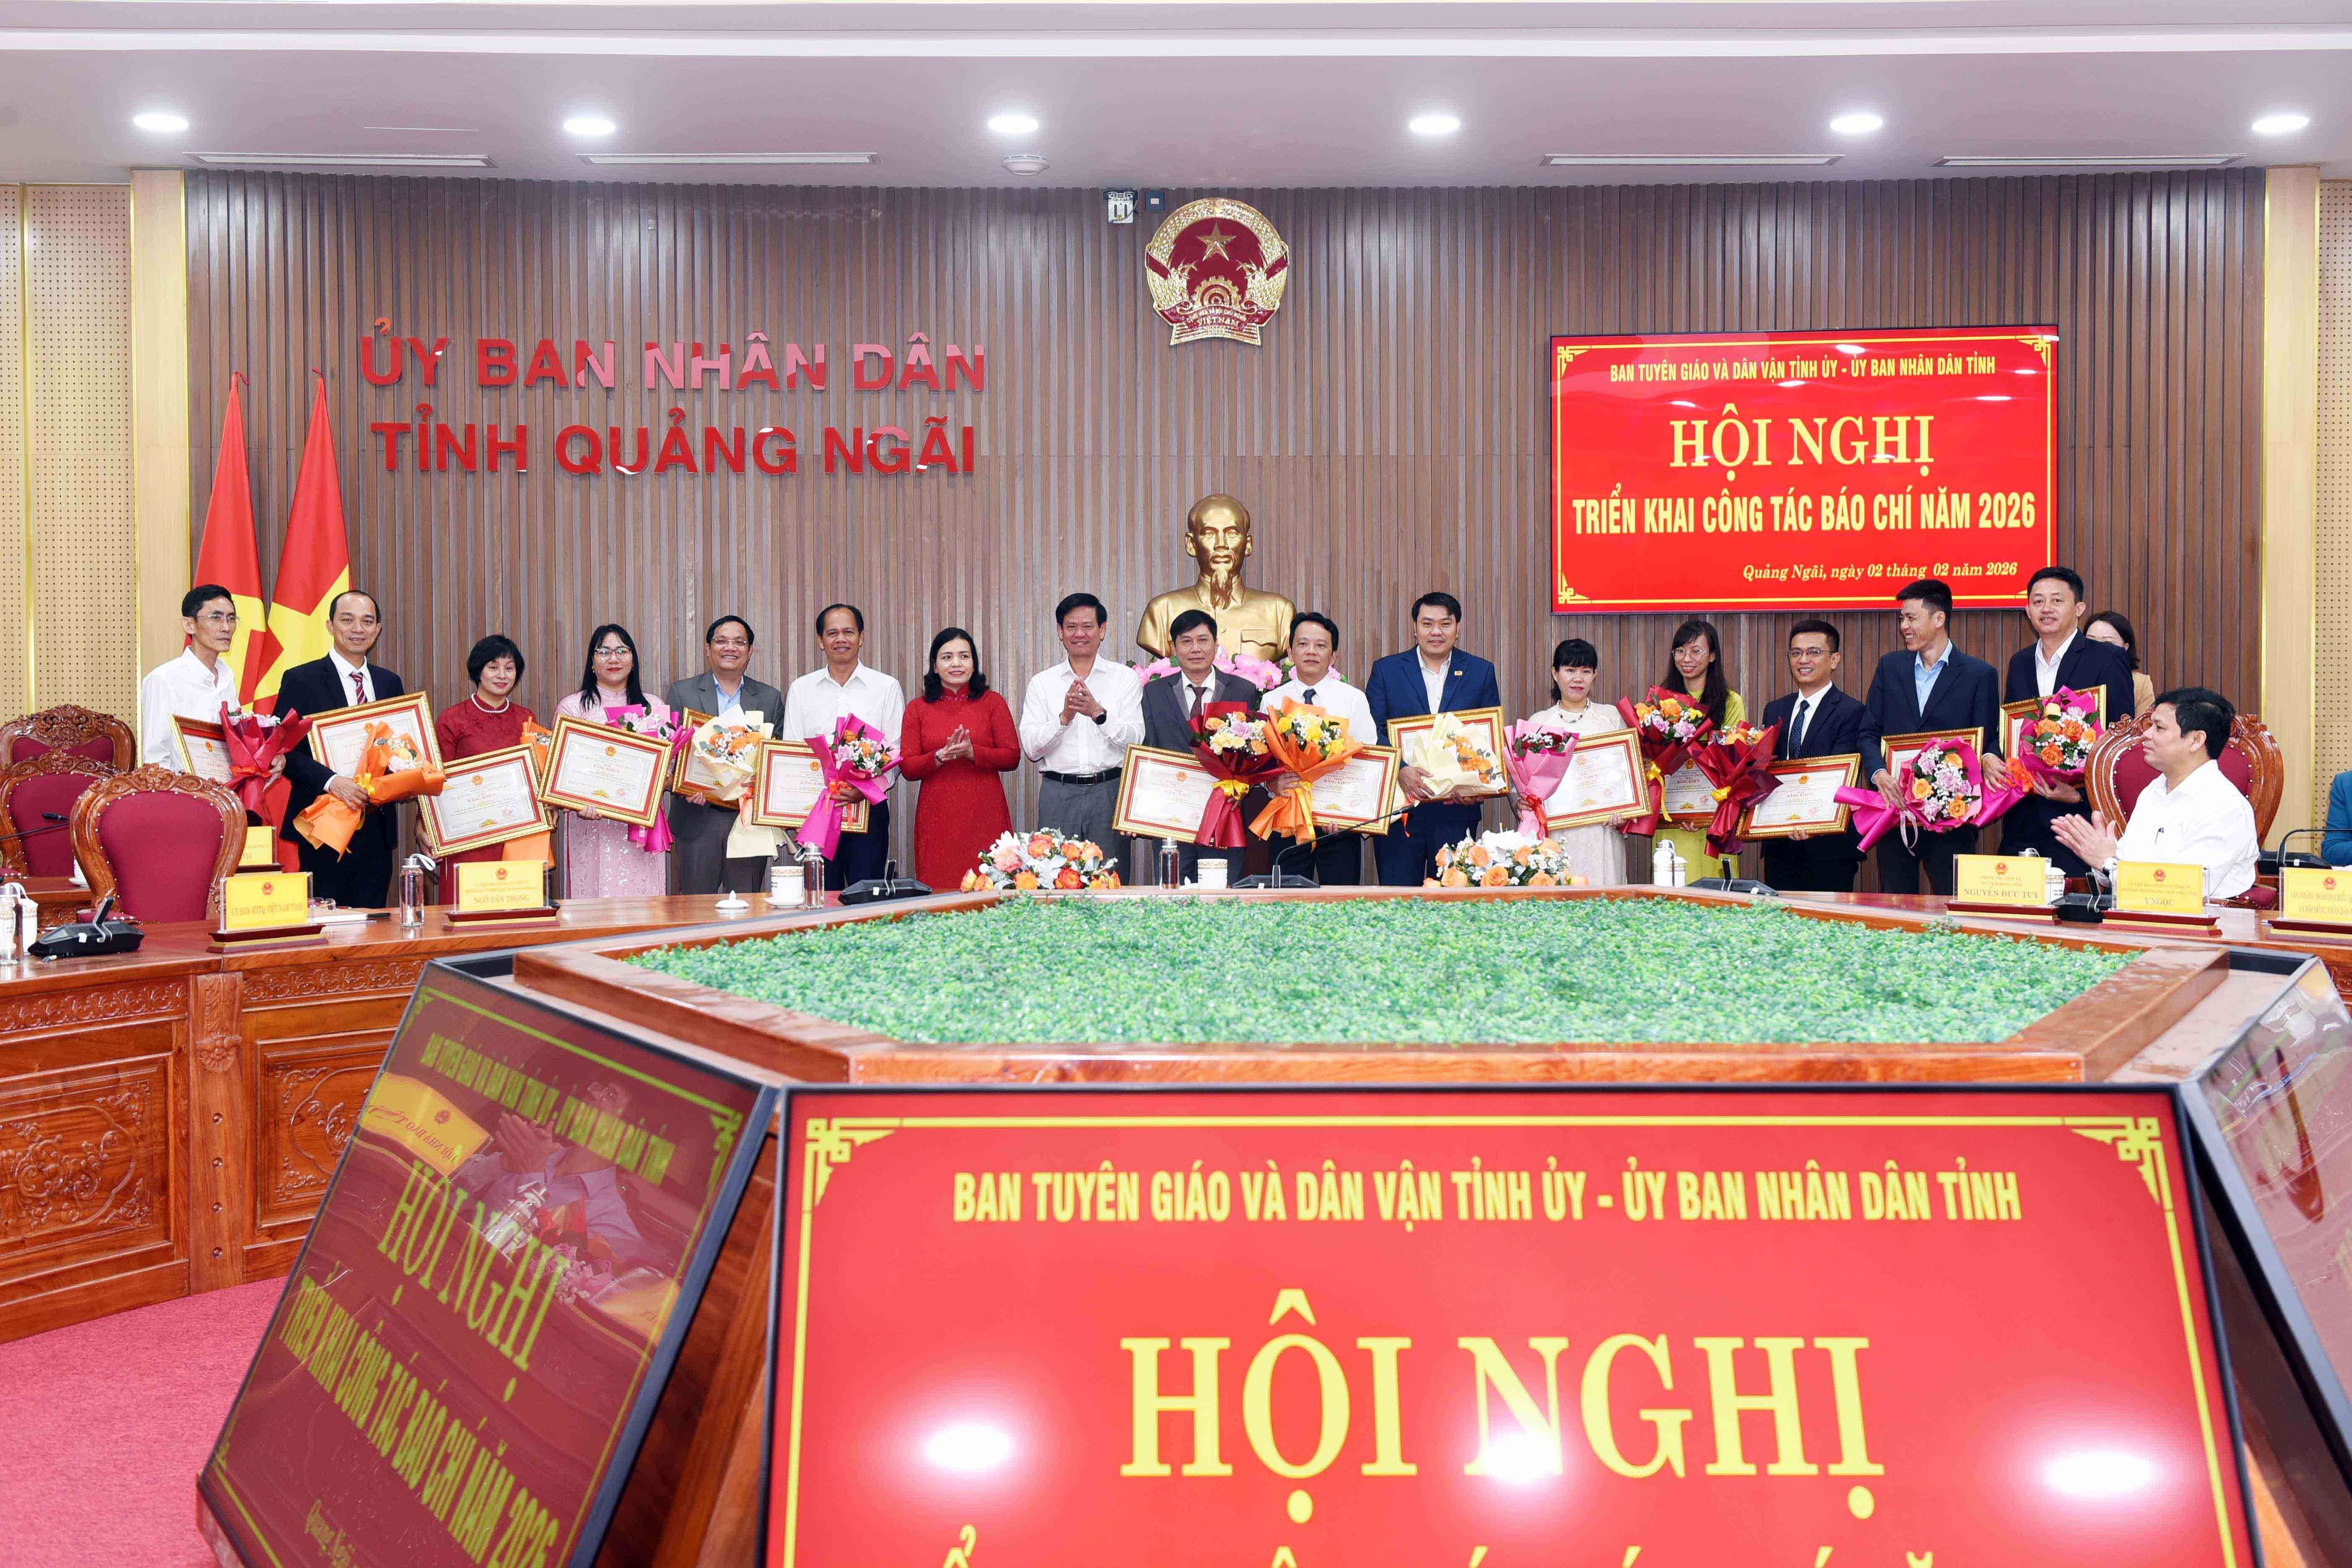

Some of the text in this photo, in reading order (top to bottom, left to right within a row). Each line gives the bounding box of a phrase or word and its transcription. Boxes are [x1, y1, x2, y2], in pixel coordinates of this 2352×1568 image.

[360, 317, 985, 392] ỦY BAN NHÂN DÂN
[1611, 364, 1634, 382] BAN
[1639, 360, 1676, 381] TUYÊN
[1681, 358, 1709, 381] GIÁO
[1713, 358, 1729, 380] VÀ
[1733, 357, 1757, 379] DÂN
[1761, 357, 1785, 382] VẬN
[1789, 355, 1817, 378] TỈNH
[1822, 354, 1838, 378] ỦY
[1851, 355, 1867, 377] ỦY
[1871, 358, 1895, 376] BAN
[1900, 353, 1933, 376] NHÂN
[1938, 353, 1962, 375] DÂN
[1966, 351, 1995, 374] TỈNH
[370, 403, 975, 475] TỈNH QUẢNG NGÃI
[1670, 403, 1934, 481] HỘI NGHỊ
[1572, 483, 2035, 534] TRIỂN KHAI CÔNG TÁC BÁO CHÍ NĂM 2026
[1743, 562, 2018, 582] Quảng Ngãi, ngày 02 tháng 02 năm 2026
[954, 1156, 2022, 1232] BAN TUYÊN GIÁO VÀ DÂN VẬN TỈNH ỦY - ỦY BAN NHÂN DÂN TỈNH
[377, 1144, 571, 1402] HỘI NGHỊ
[307, 1303, 360, 1394] KHAI
[366, 1351, 419, 1458] TÁC
[391, 1379, 448, 1491] BÁO
[1120, 1288, 1884, 1524] HỘI NGHỊ
[421, 1416, 488, 1522] CHÍ
